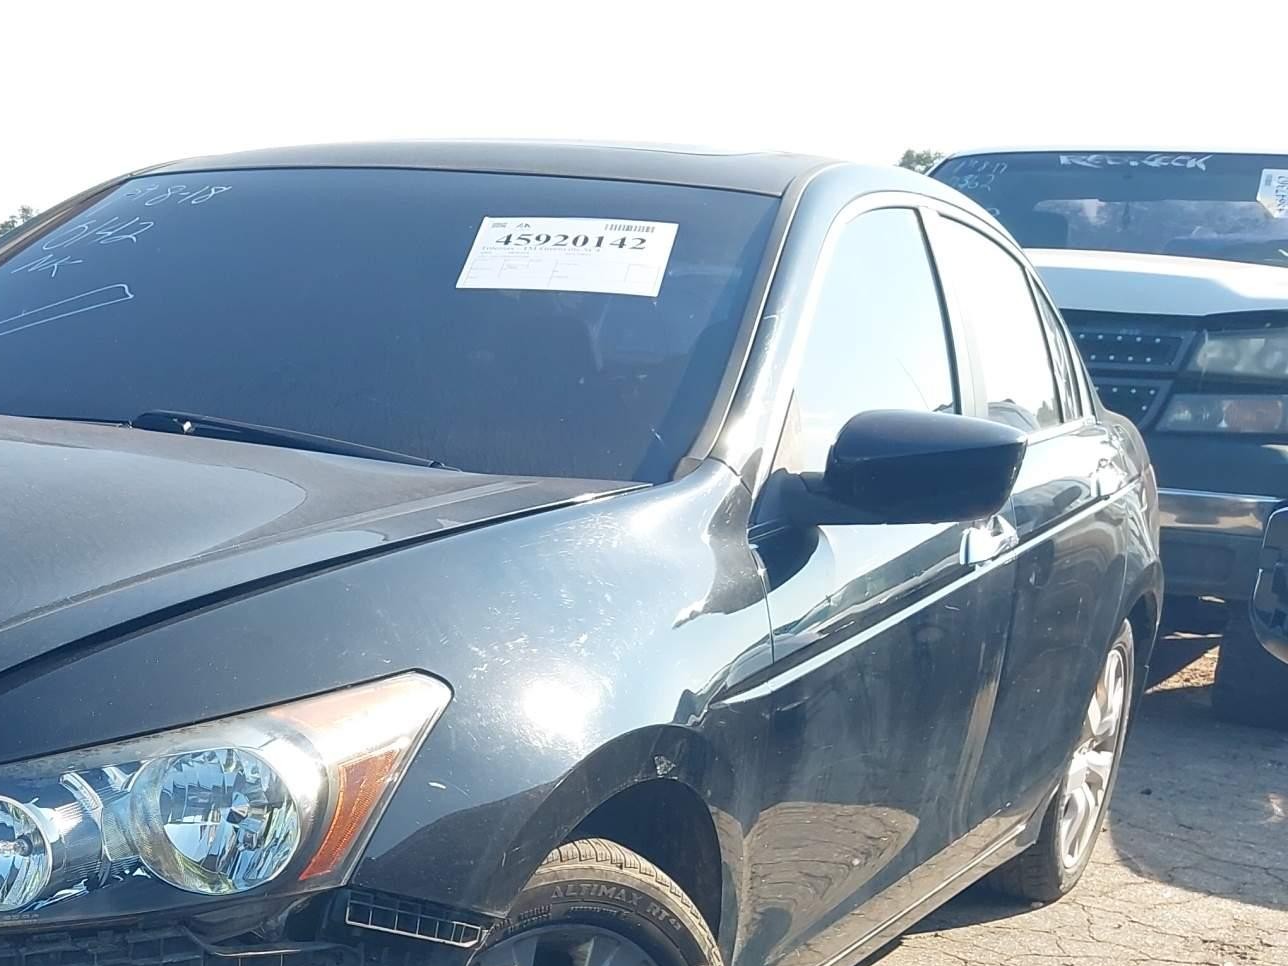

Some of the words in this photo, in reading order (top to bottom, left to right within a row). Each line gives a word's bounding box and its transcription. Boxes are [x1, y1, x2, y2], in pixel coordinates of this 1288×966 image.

[495, 233, 648, 251] 45920142
[551, 883, 643, 906] ALTIMAX
[647, 902, 669, 923] RT
